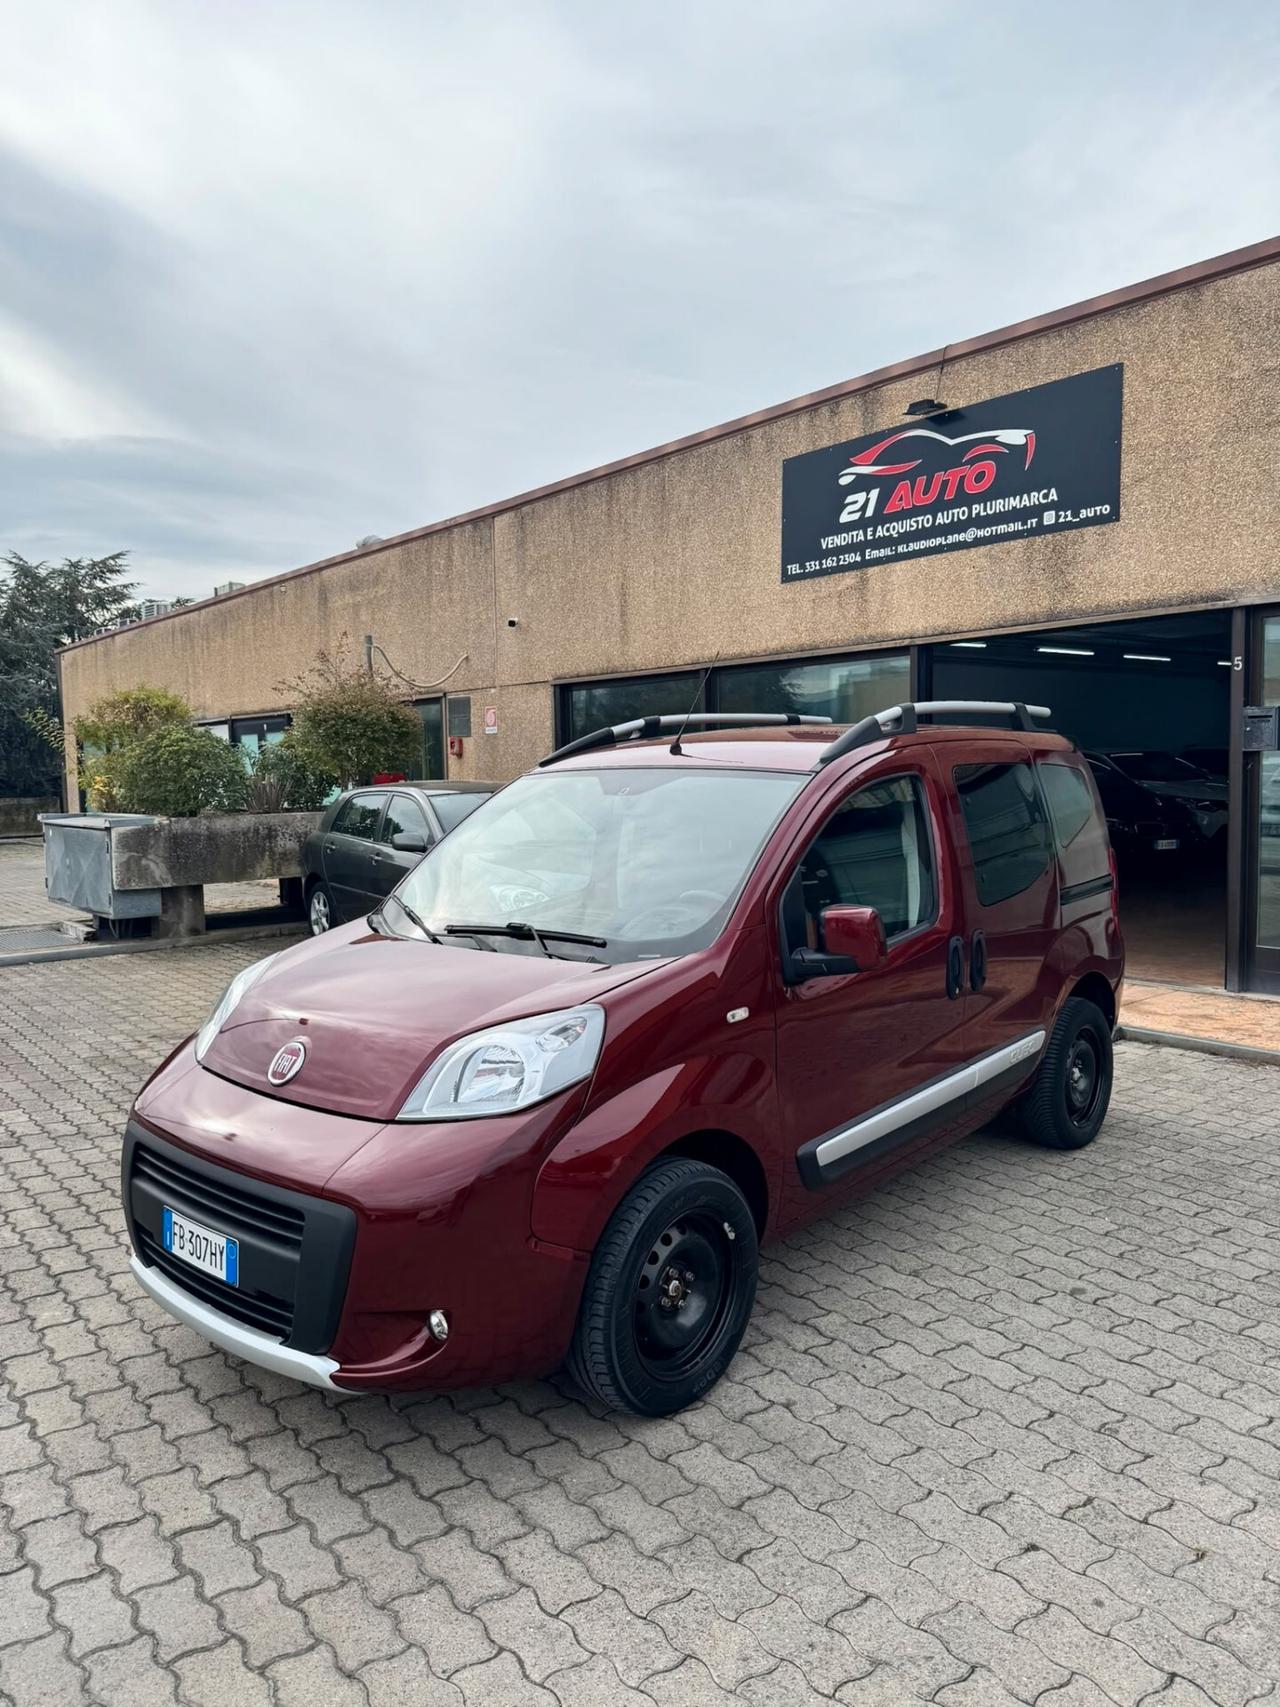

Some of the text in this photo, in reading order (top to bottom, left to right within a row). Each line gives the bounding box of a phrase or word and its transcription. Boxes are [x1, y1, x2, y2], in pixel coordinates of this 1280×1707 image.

[839, 460, 996, 523] 21 AUTO
[820, 487, 1059, 549] VENDITA E ACQUISTO AUTO PLURIMARCA
[786, 563, 804, 575] TEL.
[805, 560, 820, 572] 331
[821, 556, 837, 568] 162
[839, 551, 862, 565] 2304
[1233, 656, 1243, 671] 5
[273, 1053, 298, 1075] FIAT
